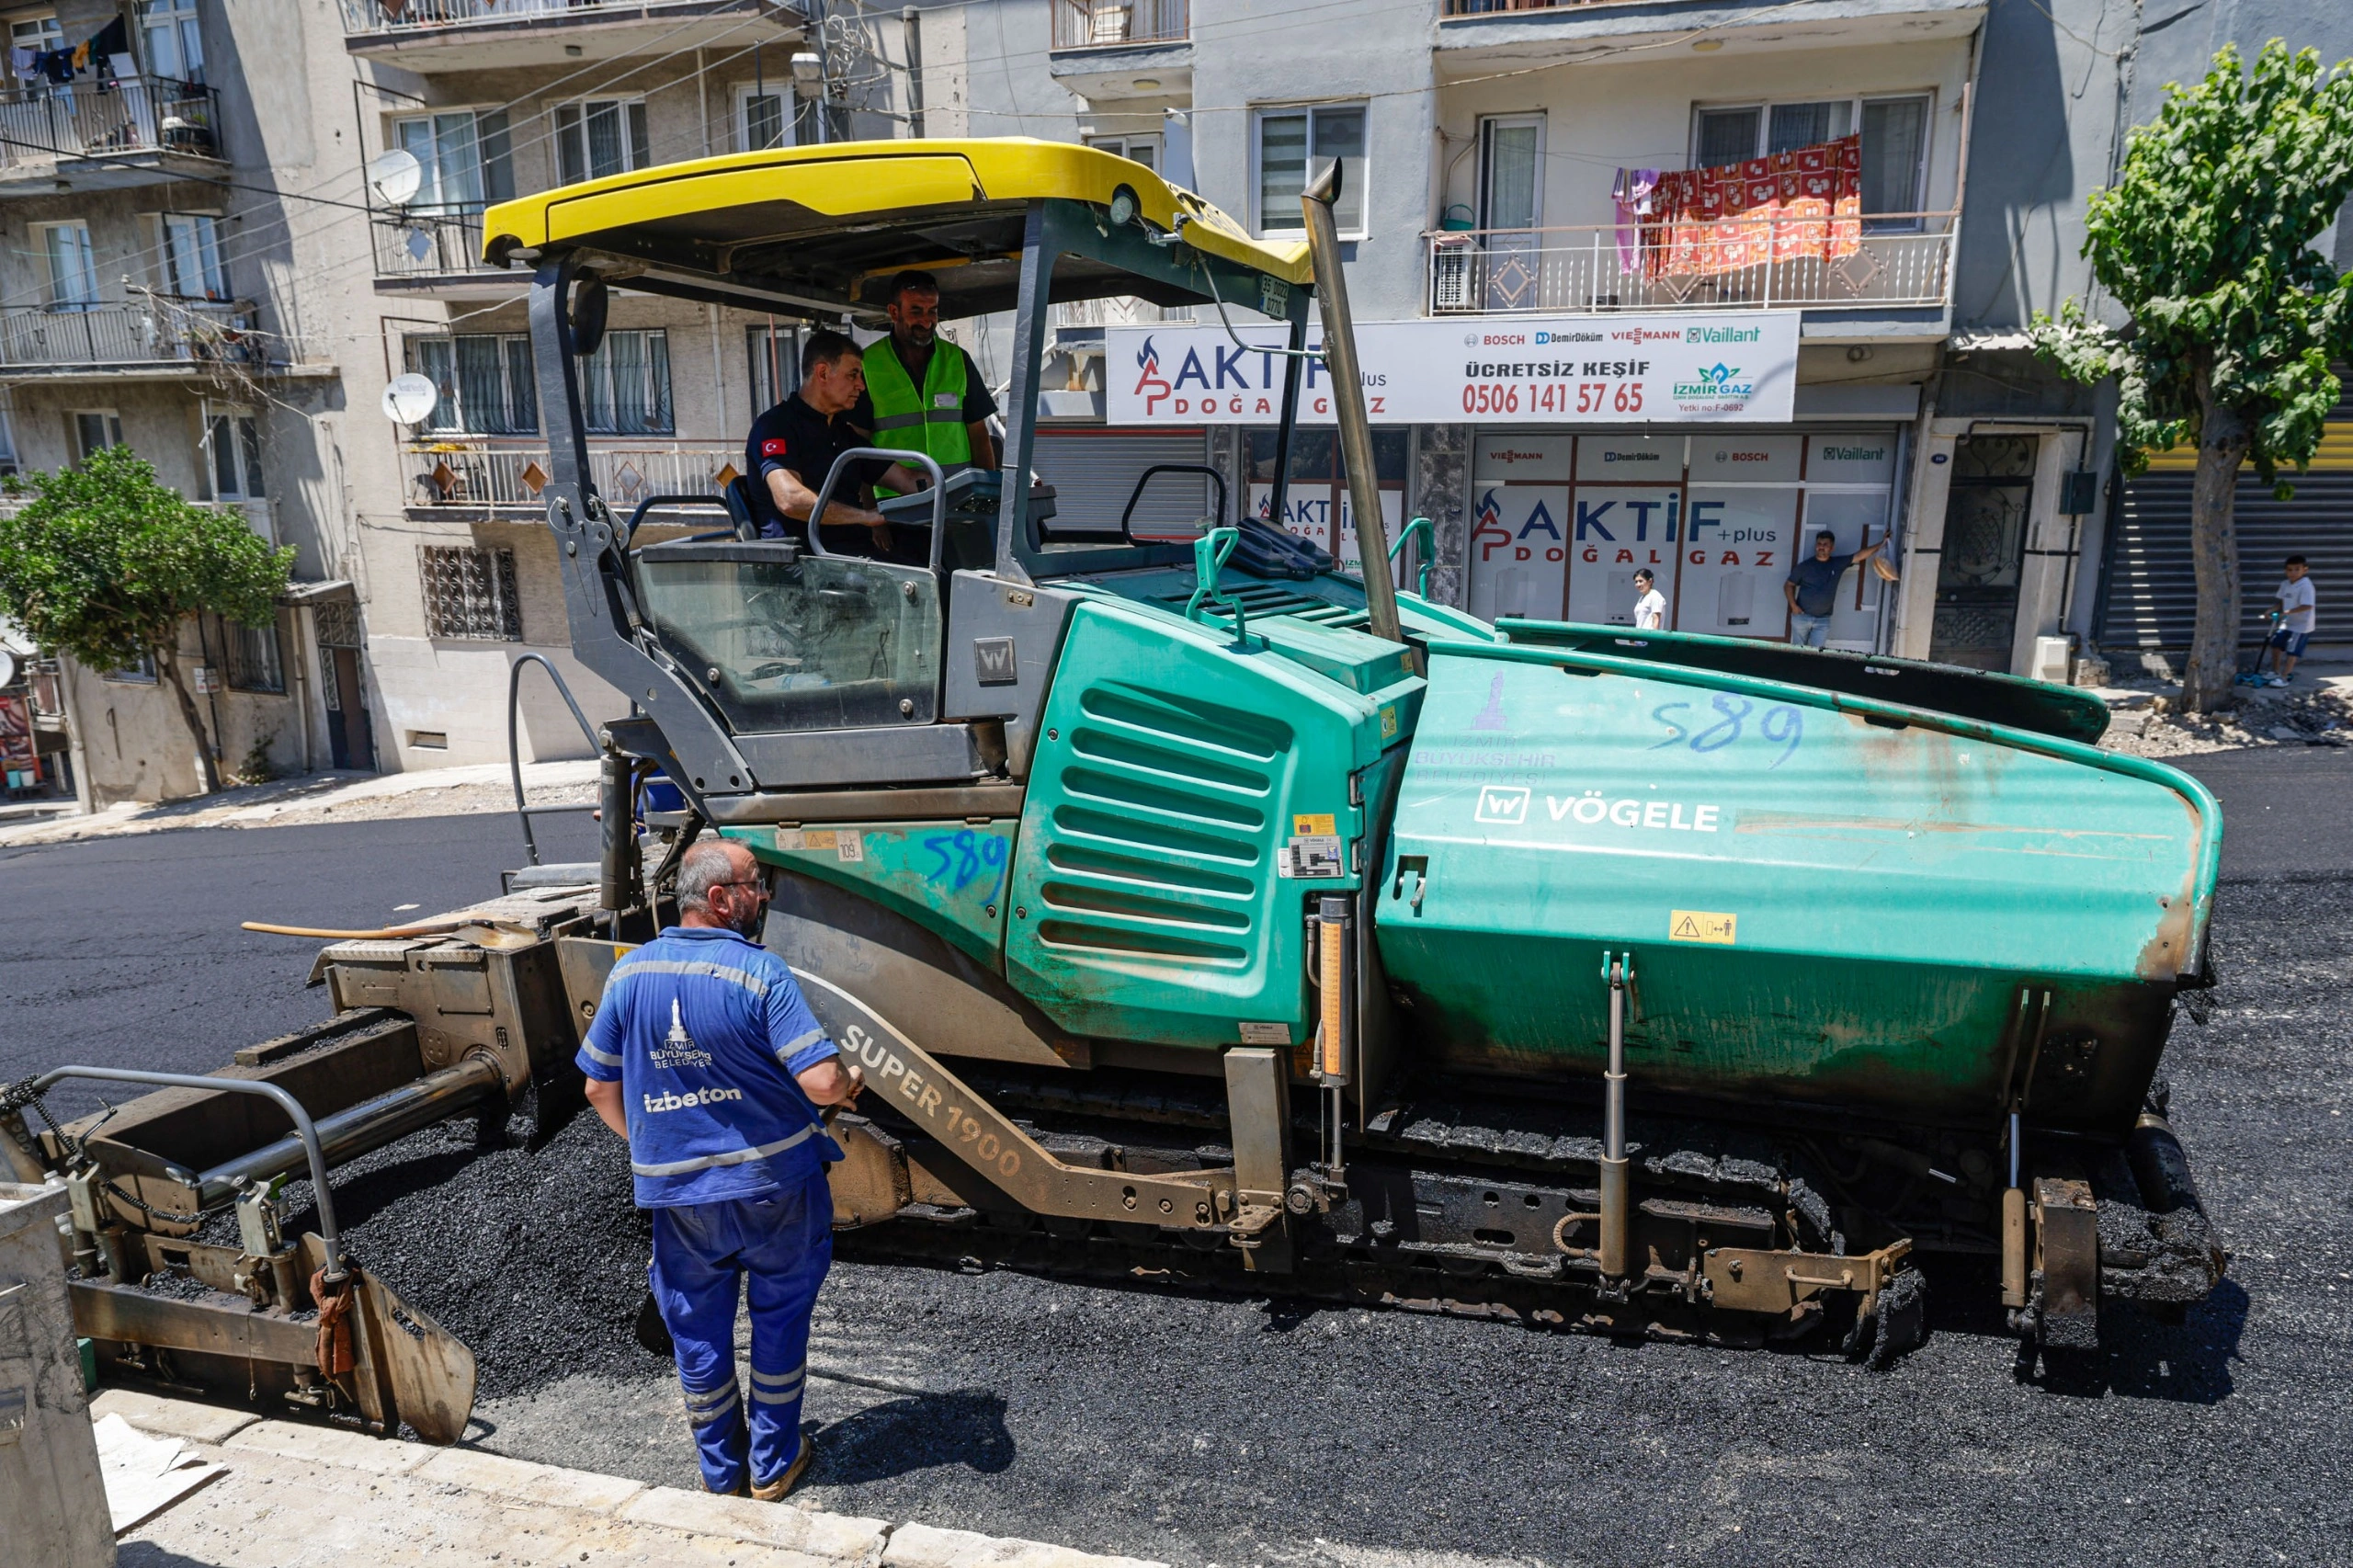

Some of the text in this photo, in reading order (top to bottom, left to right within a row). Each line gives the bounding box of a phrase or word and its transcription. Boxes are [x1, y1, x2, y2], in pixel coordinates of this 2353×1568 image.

[1263, 278, 1271, 292] 35
[1483, 335, 1525, 346] BOSCH
[1551, 332, 1604, 343] DemirDöküm
[1611, 327, 1680, 345] VIESSMANN
[1700, 326, 1761, 343] Vaillant
[1173, 344, 1331, 390] AKTF
[1465, 359, 1650, 379] ÜCRETSİZ KEŞİF
[1175, 393, 1386, 415] DOĞA GZ
[1462, 382, 1643, 414] 0506 141 57 65
[1490, 449, 1542, 463] VIESSMANN
[1618, 452, 1659, 460] DemirDöküm
[1732, 452, 1768, 461] BOSCH
[1836, 447, 1885, 460] Vaillant
[1517, 493, 1725, 542] AKTİF
[1515, 544, 1774, 566] DOĞAL GAZ
[1547, 790, 1720, 832] VÖGELE
[643, 1086, 742, 1113] izbeton
[840, 1024, 1021, 1177] SUPER 1900
